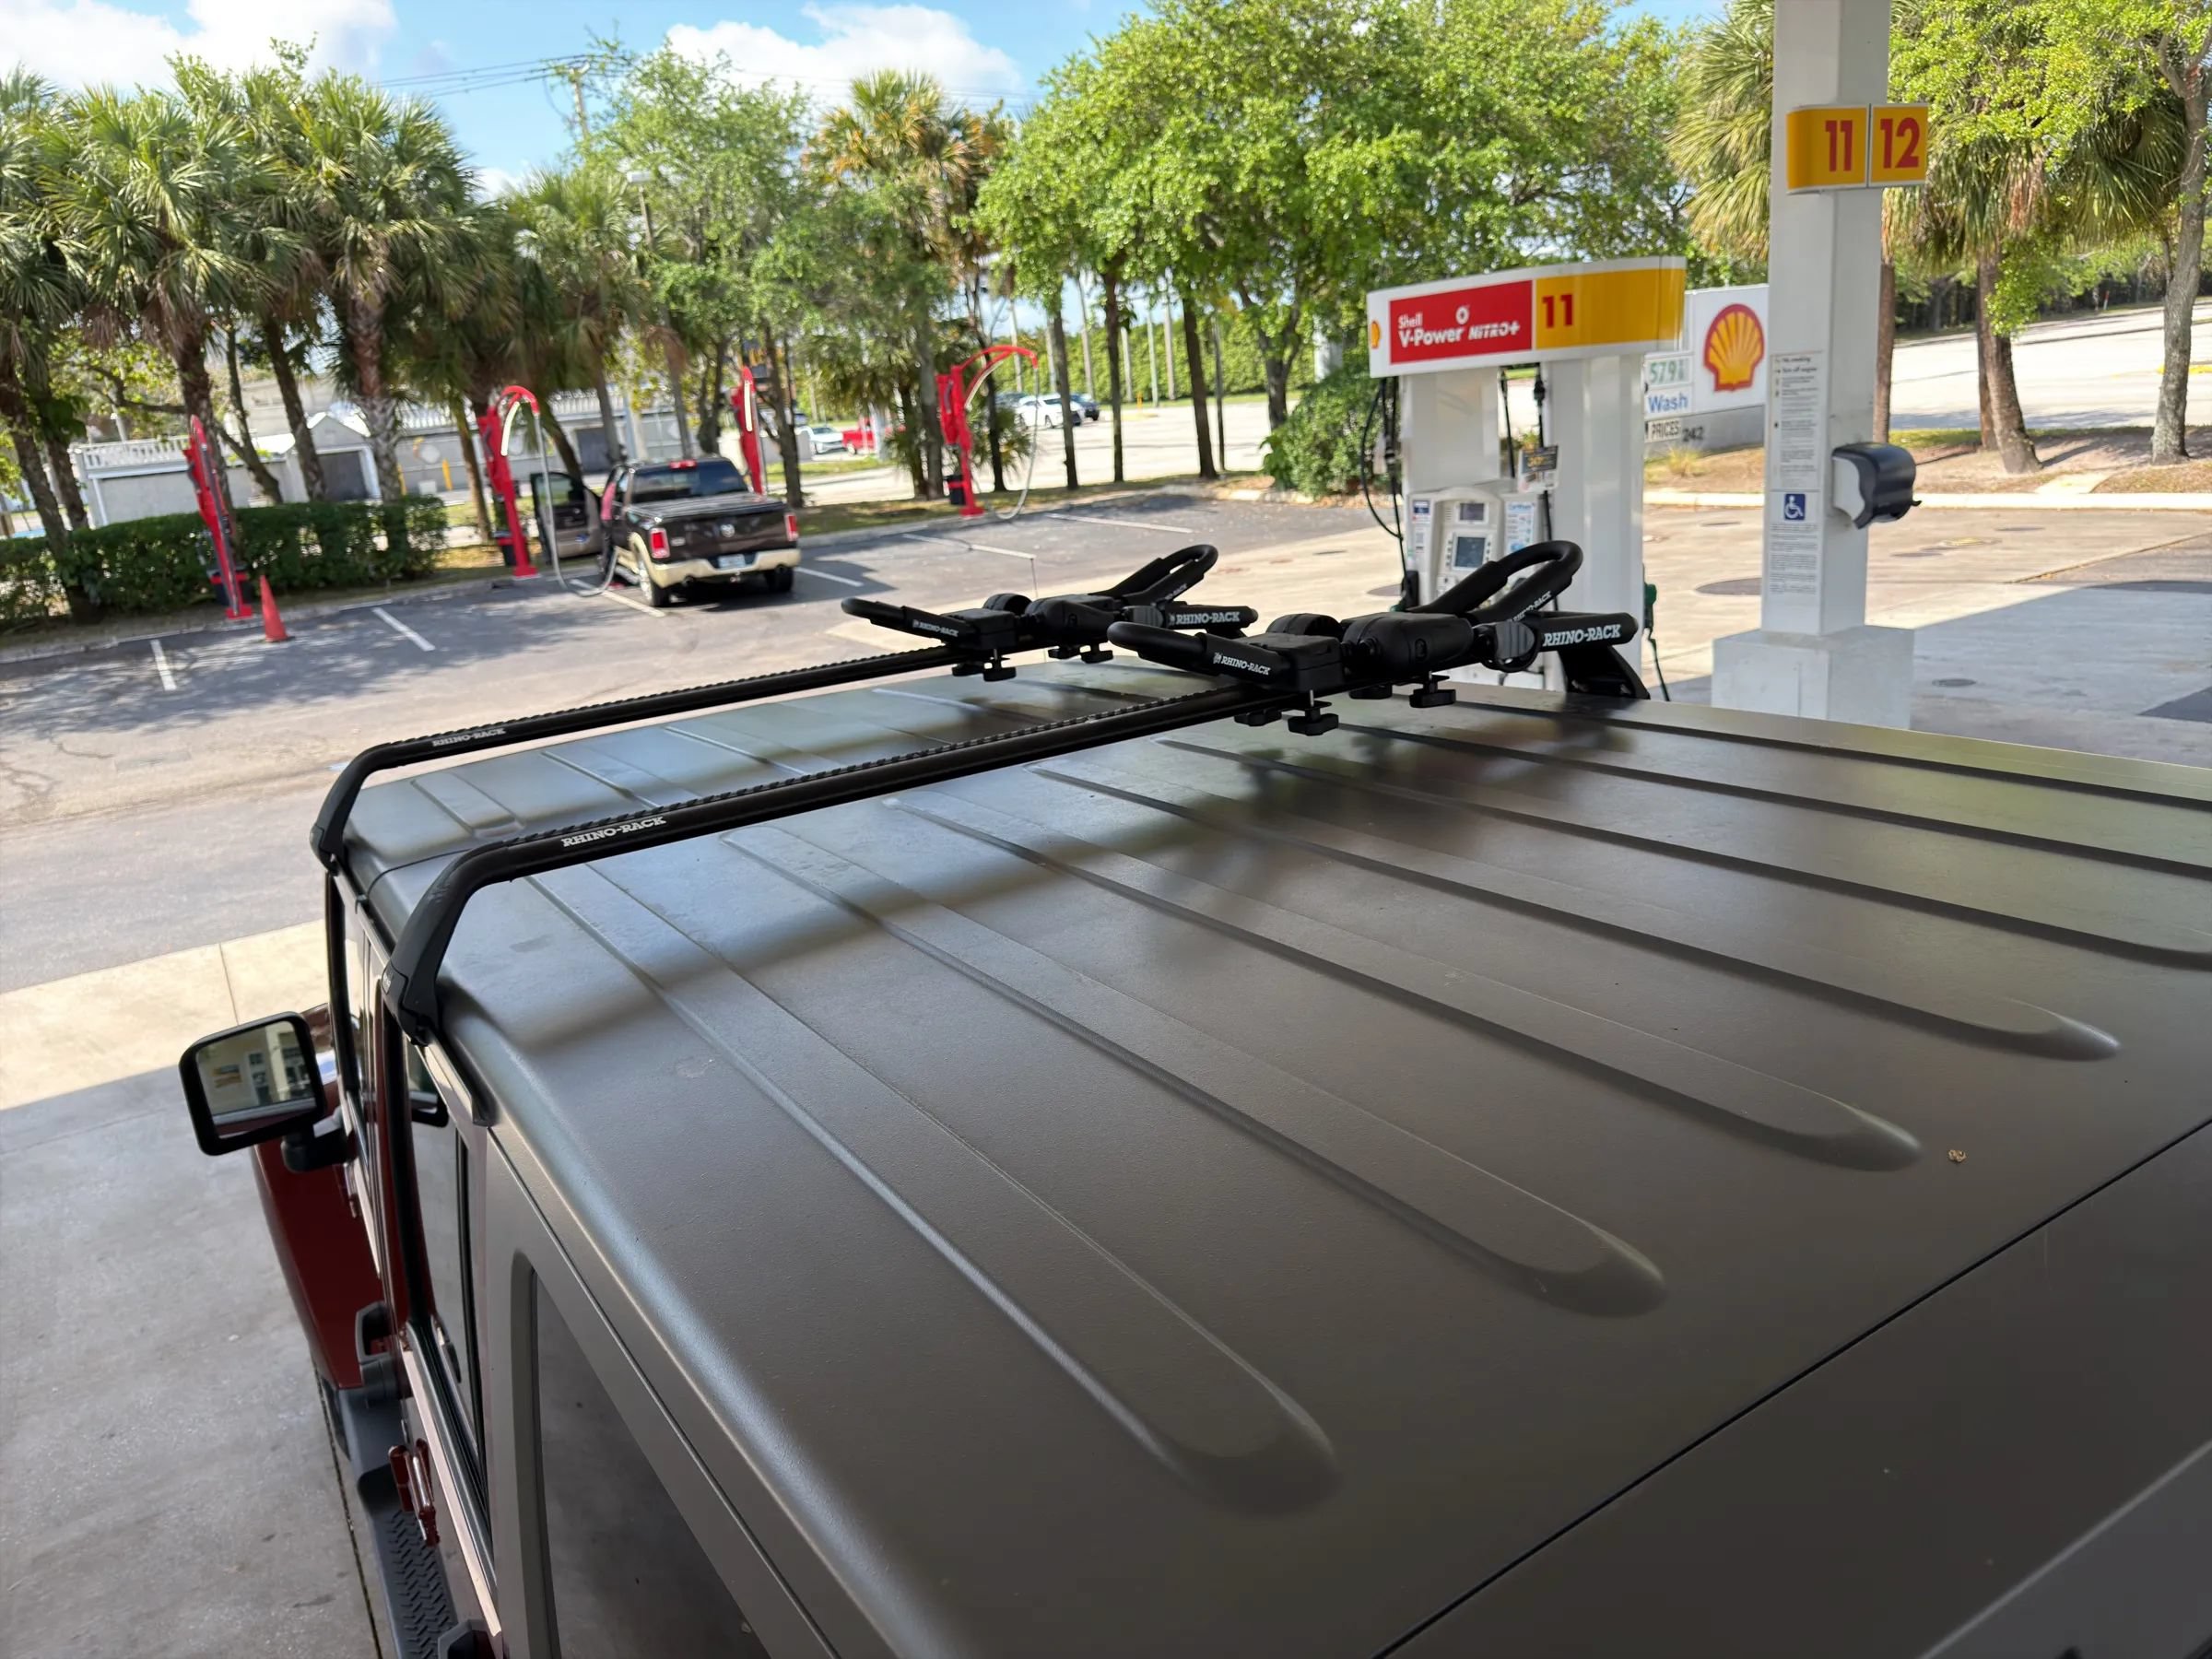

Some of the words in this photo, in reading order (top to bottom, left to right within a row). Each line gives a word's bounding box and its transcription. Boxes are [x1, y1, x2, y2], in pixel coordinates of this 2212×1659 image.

[1825, 119, 1853, 172] 11
[1880, 117, 1920, 169] 12
[1398, 312, 1423, 329] Shell
[1541, 293, 1574, 328] 11
[1398, 326, 1465, 348] V-Power
[1648, 393, 1688, 413] Wash
[1682, 425, 1704, 442] 242
[1176, 611, 1241, 625] RHINO-RACK
[1542, 624, 1621, 647] RHINO-RACK
[1220, 655, 1271, 676] RHINO-RACK
[432, 727, 506, 747] RHINO-RACK
[561, 816, 666, 848] RHINO-RACK
